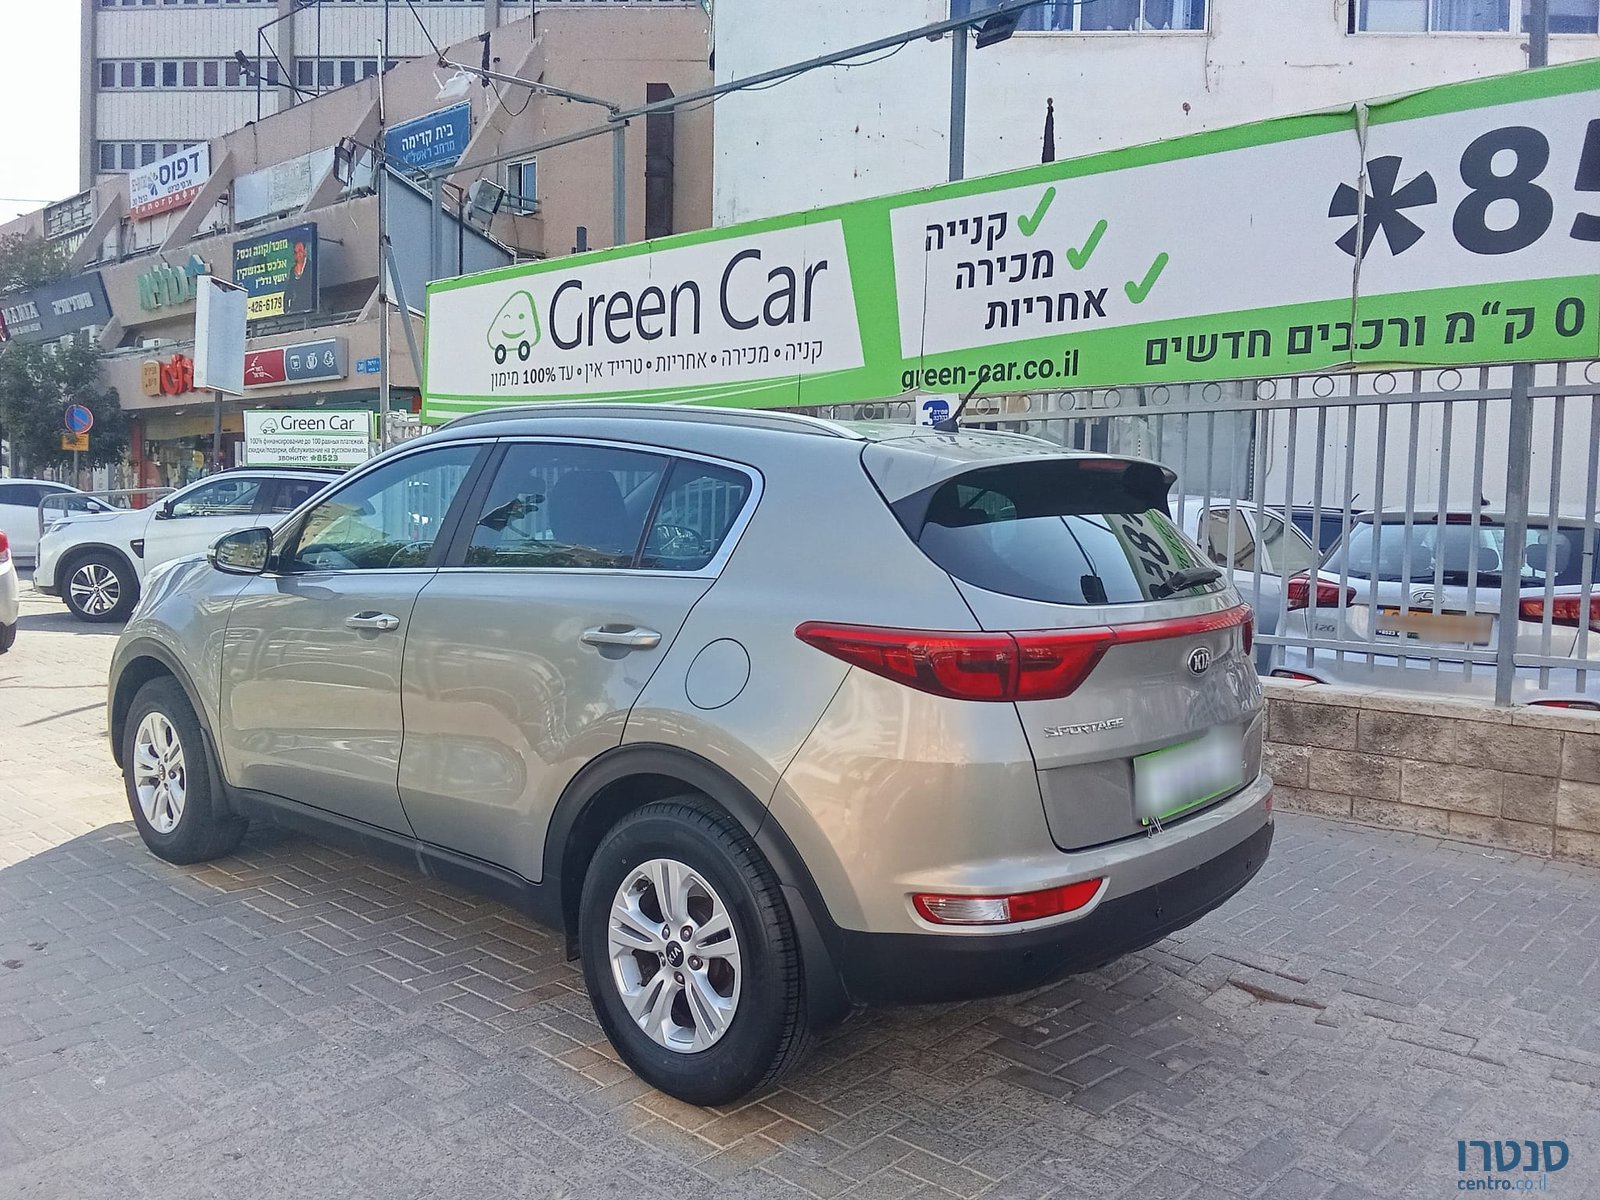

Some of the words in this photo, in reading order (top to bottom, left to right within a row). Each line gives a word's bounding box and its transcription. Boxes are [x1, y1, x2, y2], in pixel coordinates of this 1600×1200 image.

[435, 123, 454, 141] בית
[159, 152, 200, 185] דפוס
[926, 211, 1008, 251] קנייה
[956, 249, 1054, 290] מכירה
[549, 279, 701, 351] Green
[719, 248, 828, 331] Car
[984, 287, 1109, 330] אחריות
[1555, 296, 1585, 339] 0
[1287, 315, 1425, 356] ורכבים
[721, 346, 769, 367] מכירה
[785, 340, 823, 364] קניה
[1145, 329, 1272, 367] חדשים
[558, 366, 574, 381] עד
[585, 361, 603, 384] אין
[607, 357, 643, 377] טרייד
[655, 352, 707, 373] אחריות
[901, 349, 1079, 393] green-car.co.il
[491, 370, 519, 392] מימון
[523, 367, 557, 385] 100%
[281, 415, 326, 431] Green
[329, 415, 355, 430] Car
[1043, 717, 1124, 739] SPORTAGE
